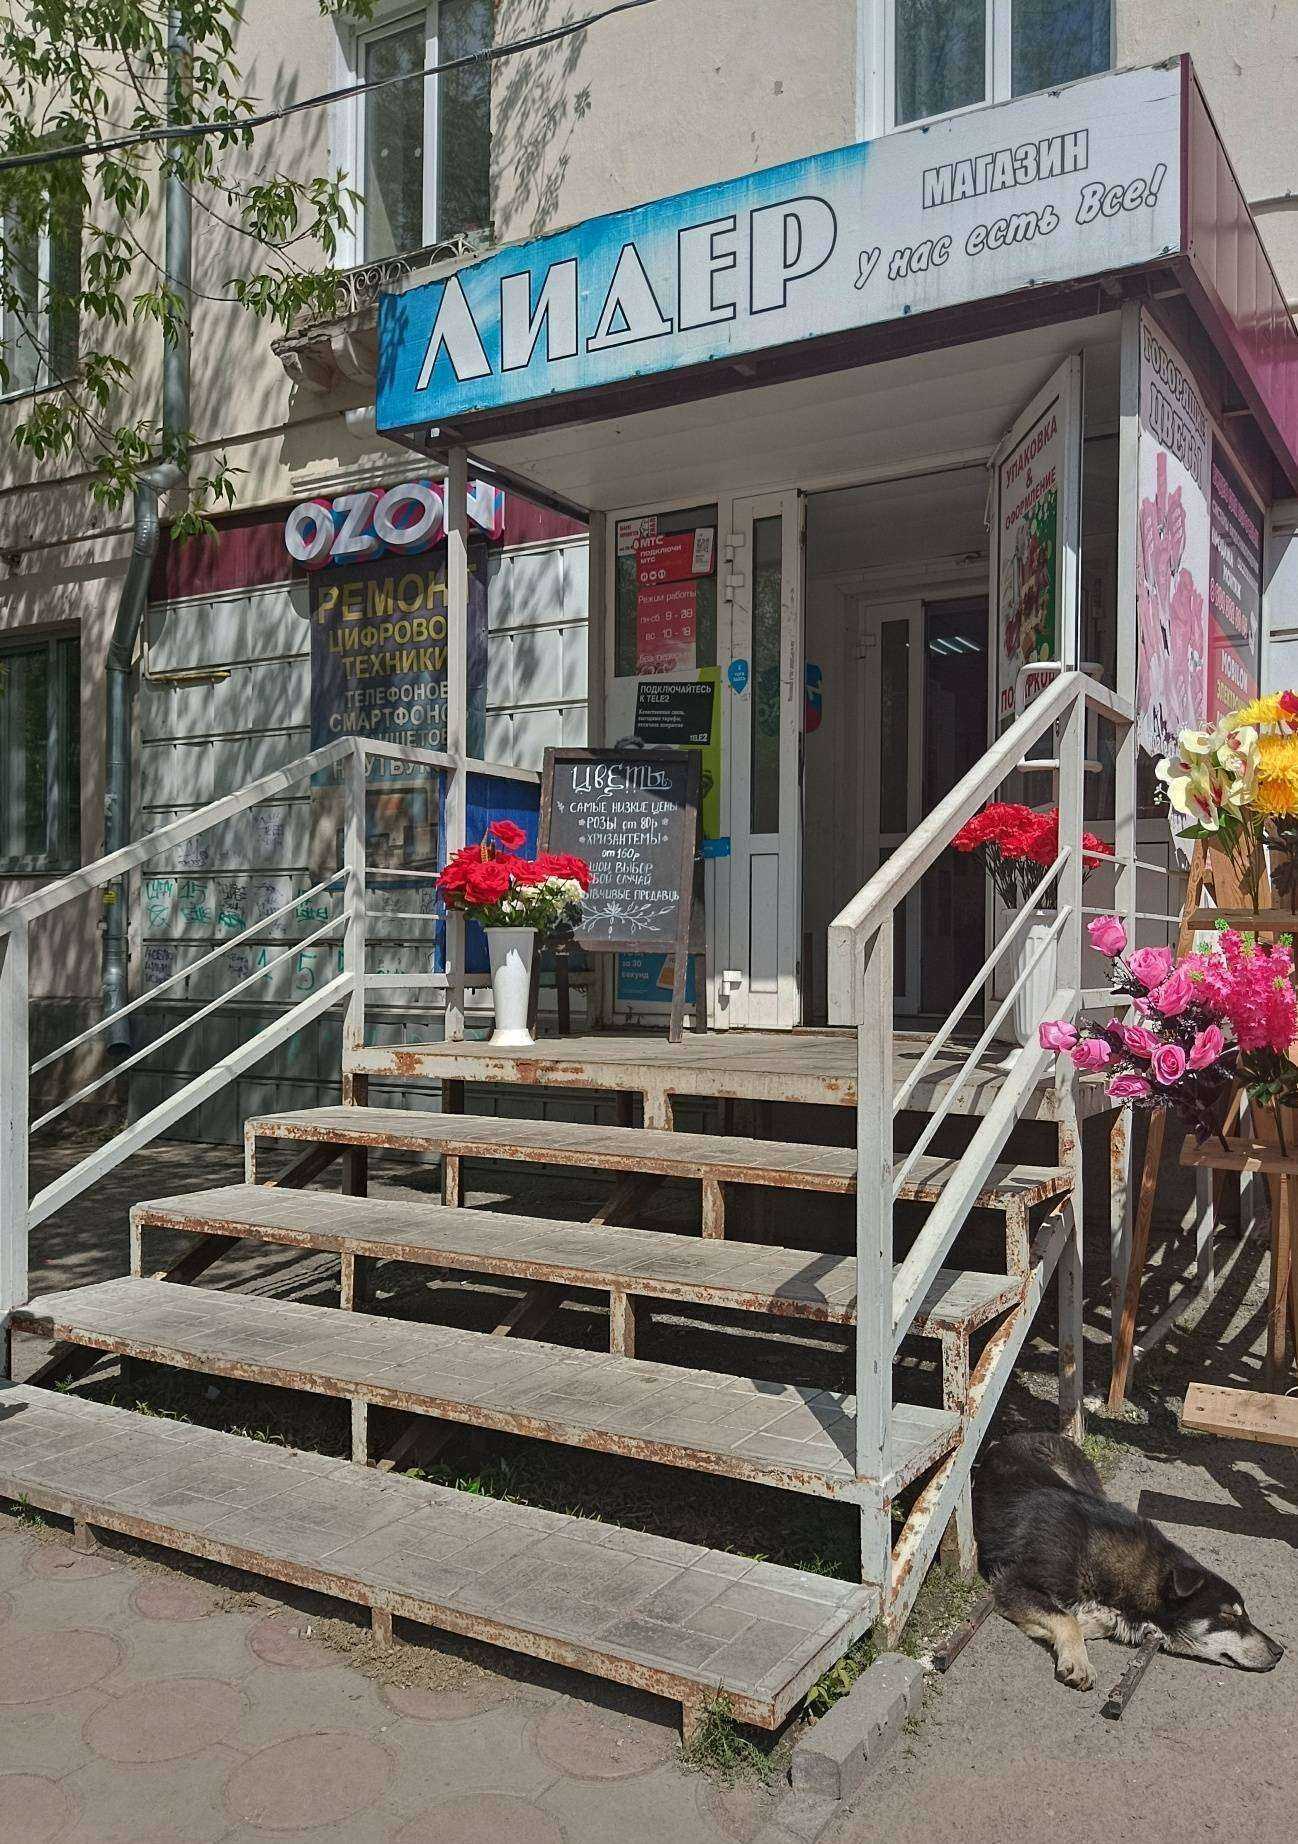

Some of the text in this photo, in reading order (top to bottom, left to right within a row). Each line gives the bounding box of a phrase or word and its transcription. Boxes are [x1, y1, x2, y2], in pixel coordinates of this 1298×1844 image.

[922, 128, 1089, 210] МАГАЗИН
[887, 234, 953, 281] нас
[965, 205, 1059, 256] есть
[1075, 163, 1168, 225] Все!
[415, 195, 838, 392] ЛИДЕР
[1006, 415, 1057, 489] УПАКОВКА
[1005, 466, 1056, 530] ОФОРМЛЕНИЕ
[284, 476, 505, 563] OZON
[318, 563, 477, 624] РЕМОН
[329, 615, 448, 654] ЦИФРОВО
[640, 684, 712, 694] ПОДКЛЮЧАЙТЕСЬ
[329, 704, 469, 733] СМАРТФОН
[569, 801, 678, 815] САМЫЕ НИЗКИЕ ЦЕНЫ
[586, 816, 617, 830] РОЗЫ
[586, 832, 661, 845] ХРИЗАНТЕМЫ
[602, 848, 640, 861] от 160р
[615, 861, 653, 874] ВЫБОР
[589, 872, 612, 884] БОЙ
[583, 888, 631, 900] ЫВЧИВЫЕ
